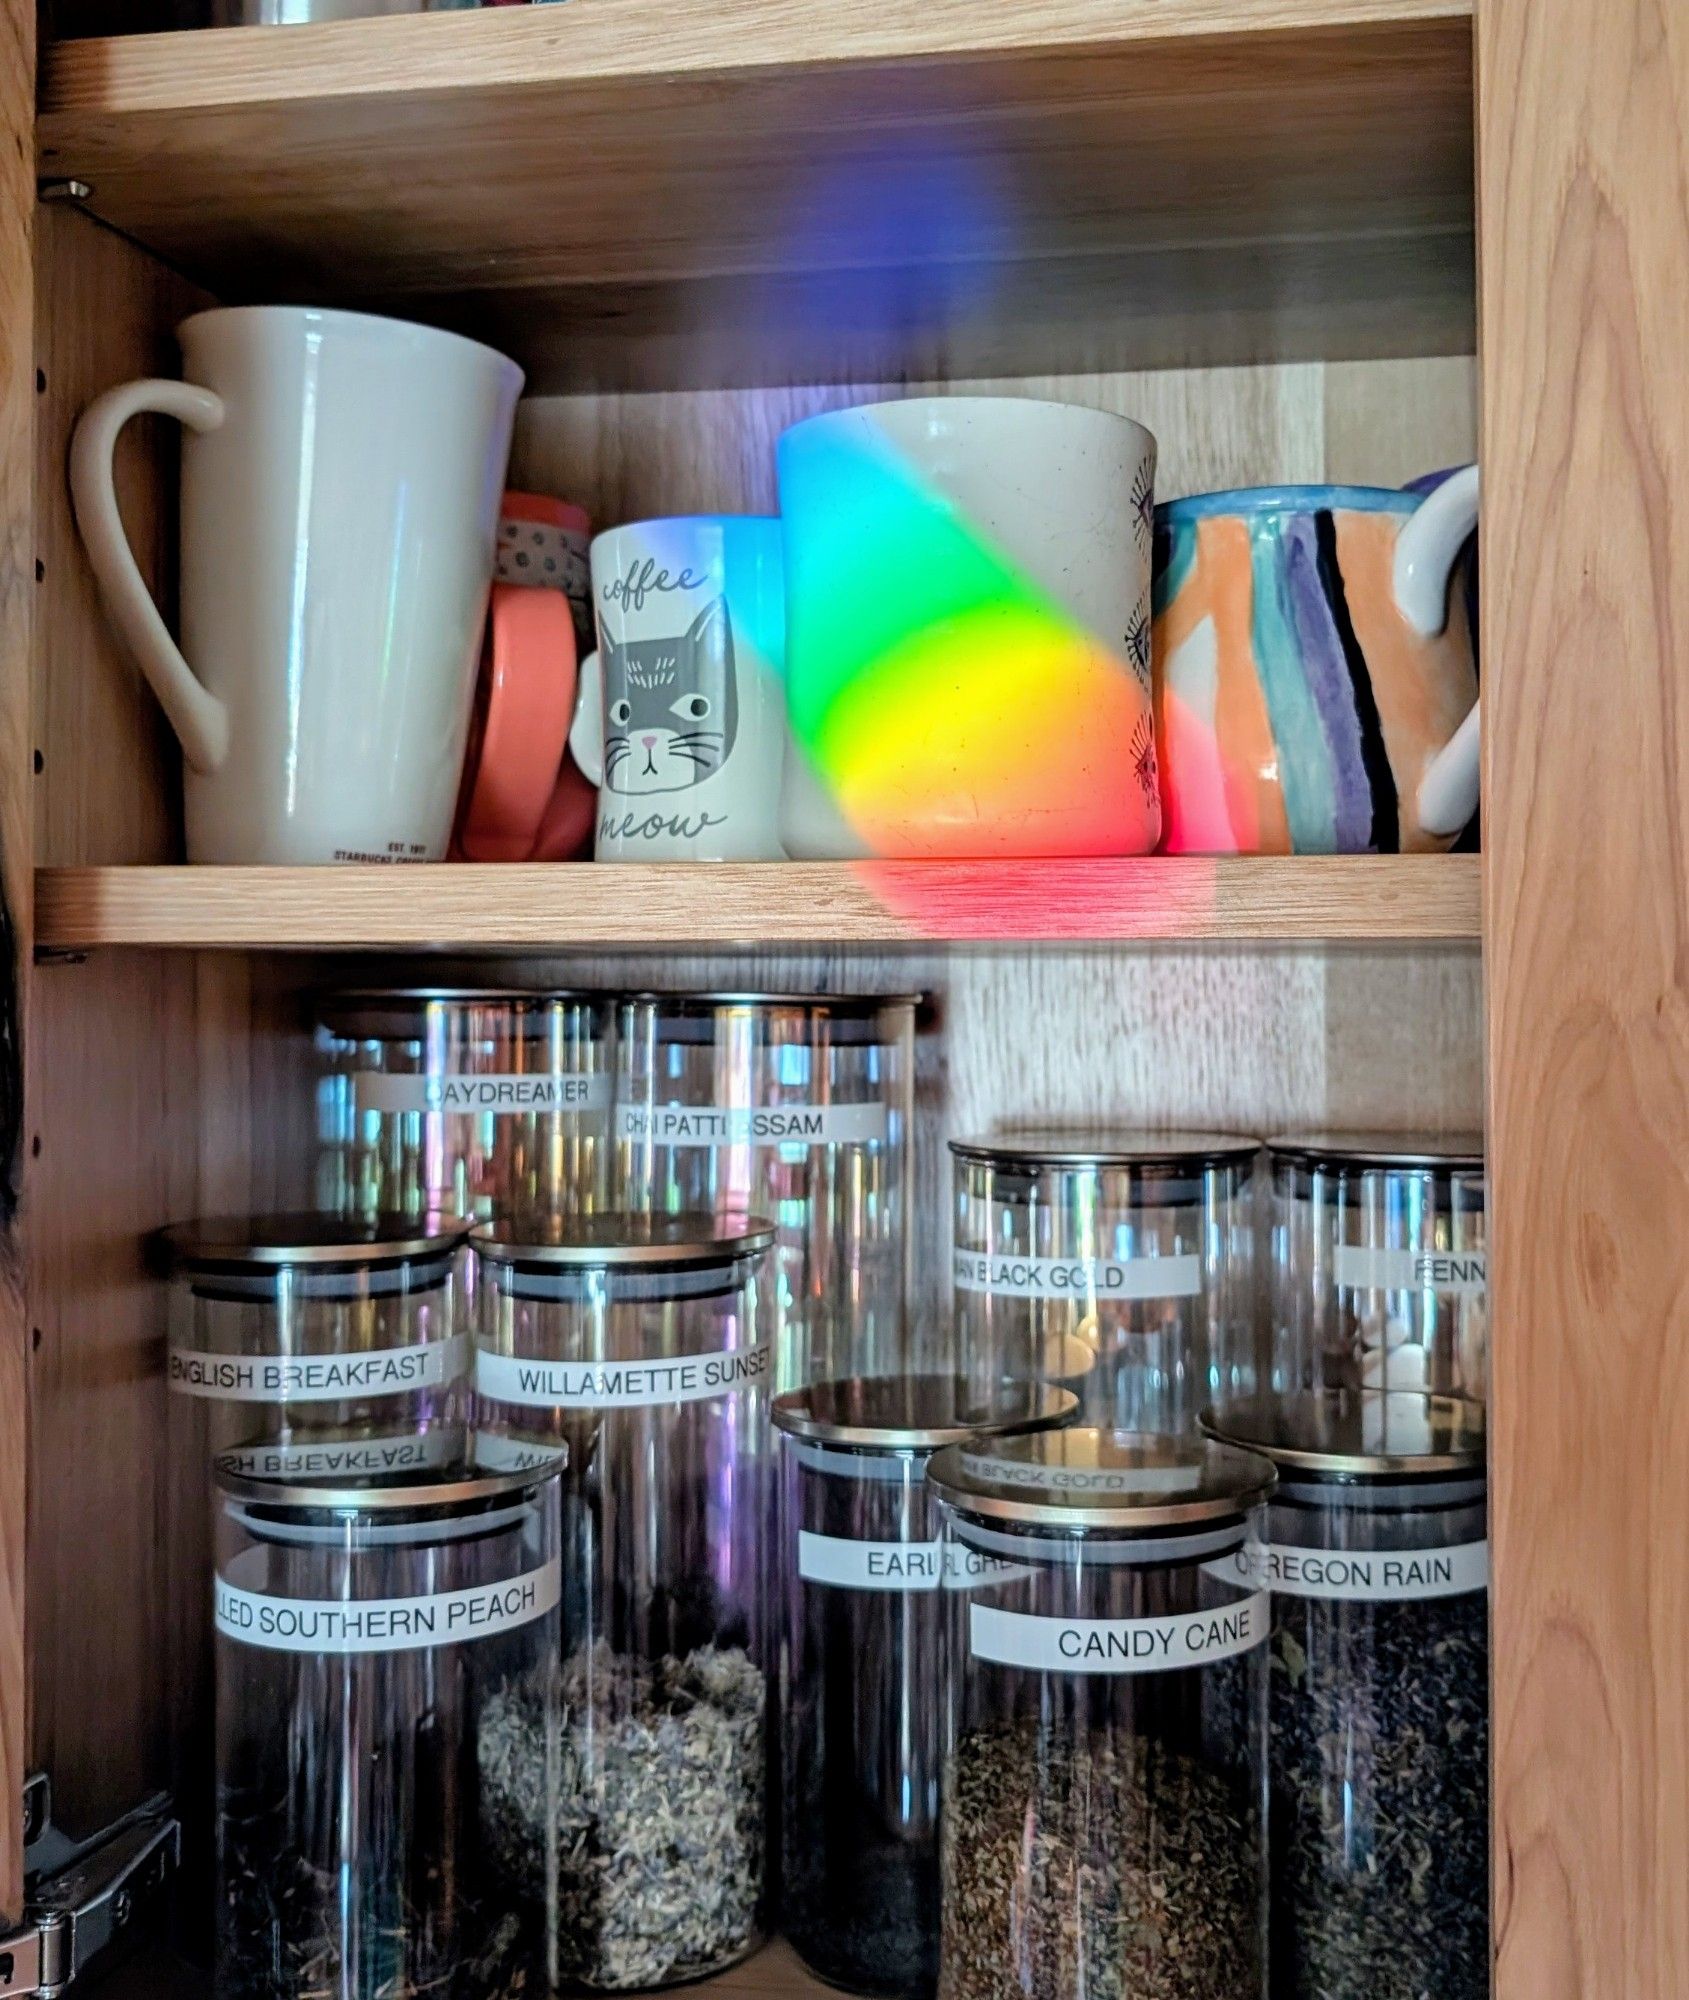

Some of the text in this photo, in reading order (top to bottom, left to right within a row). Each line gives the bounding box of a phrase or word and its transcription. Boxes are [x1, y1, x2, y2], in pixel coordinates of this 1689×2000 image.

[603, 557, 709, 614] coffee
[599, 811, 728, 840] meow
[430, 1080, 589, 1104] AYDREAMER
[665, 1114, 726, 1136] PATTI
[736, 1113, 823, 1137] SSAM
[977, 1260, 1043, 1287] BLACK
[1049, 1265, 1124, 1288] GOLD
[264, 1352, 429, 1389] BREAKFAST
[519, 1365, 697, 1395] WILLAMETTE
[1383, 1557, 1451, 1586] RAIN
[259, 1605, 435, 1639] SOUTHERN
[448, 1581, 536, 1629] PEACH
[1058, 1609, 1250, 1658] CANDY CANE
